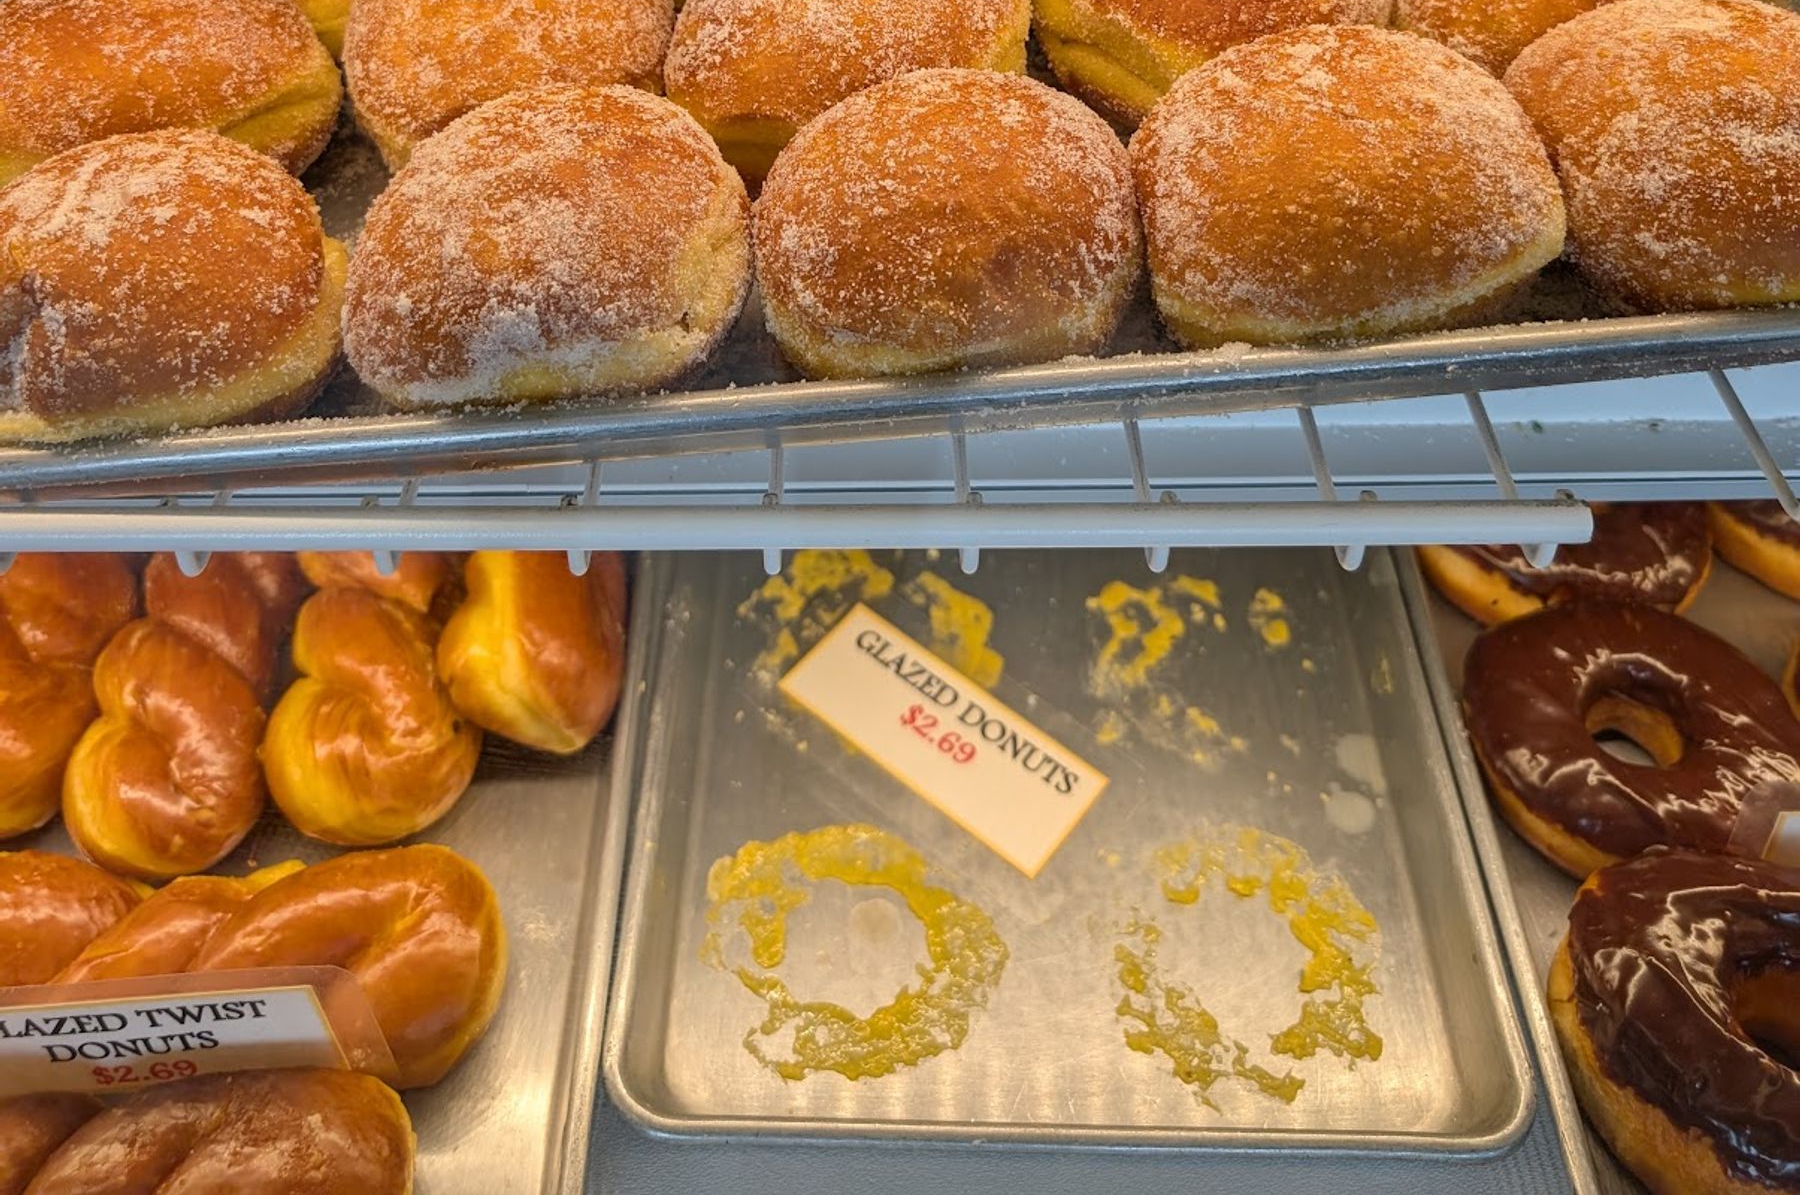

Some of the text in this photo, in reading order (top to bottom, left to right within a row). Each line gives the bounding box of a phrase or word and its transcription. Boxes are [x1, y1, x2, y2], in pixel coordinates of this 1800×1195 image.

[856, 629, 1079, 795] GLAZED DONUTS
[900, 704, 976, 765] $2.69
[0, 1000, 266, 1039] LAZED TWIST
[42, 1030, 219, 1063] DONUTS
[92, 1060, 198, 1086] $2.69
